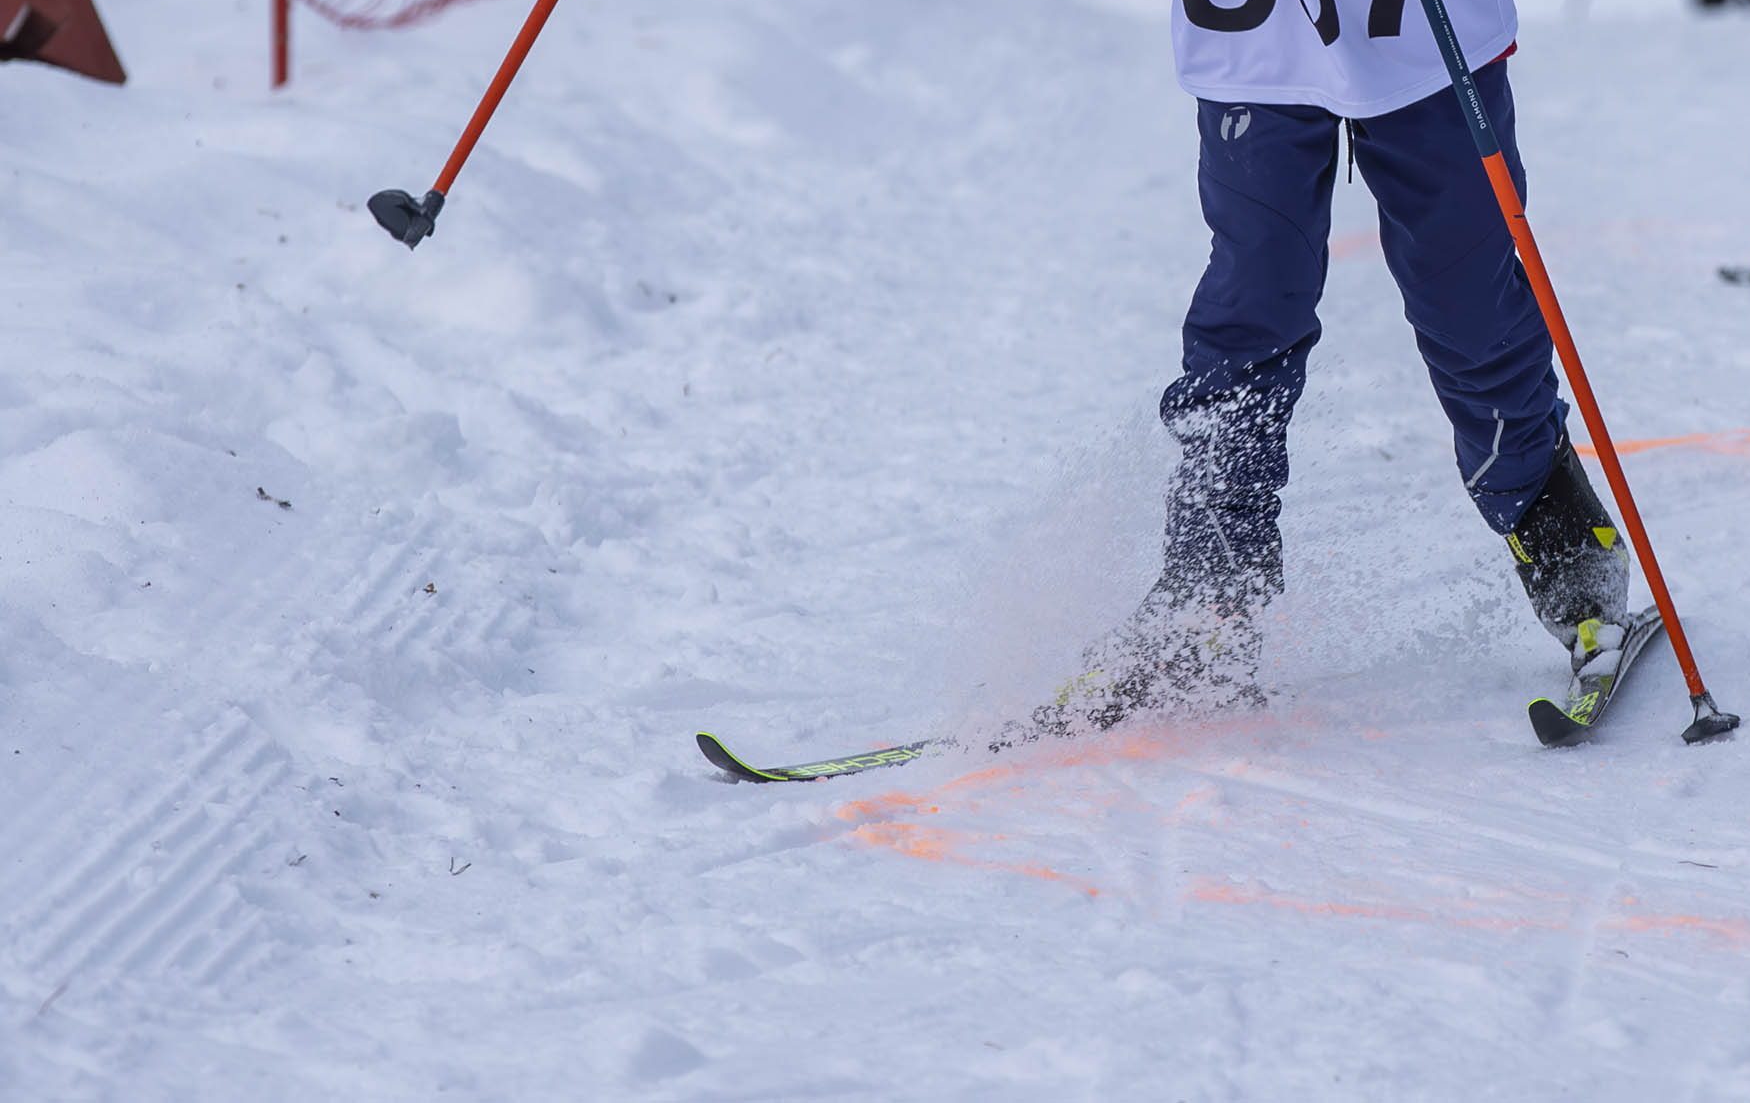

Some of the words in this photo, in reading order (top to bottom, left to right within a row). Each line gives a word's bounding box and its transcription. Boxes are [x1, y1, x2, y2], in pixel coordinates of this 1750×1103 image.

[1462, 75, 1471, 86] JR
[1466, 88, 1487, 130] DIAMOND
[796, 748, 922, 777] ISCHER
